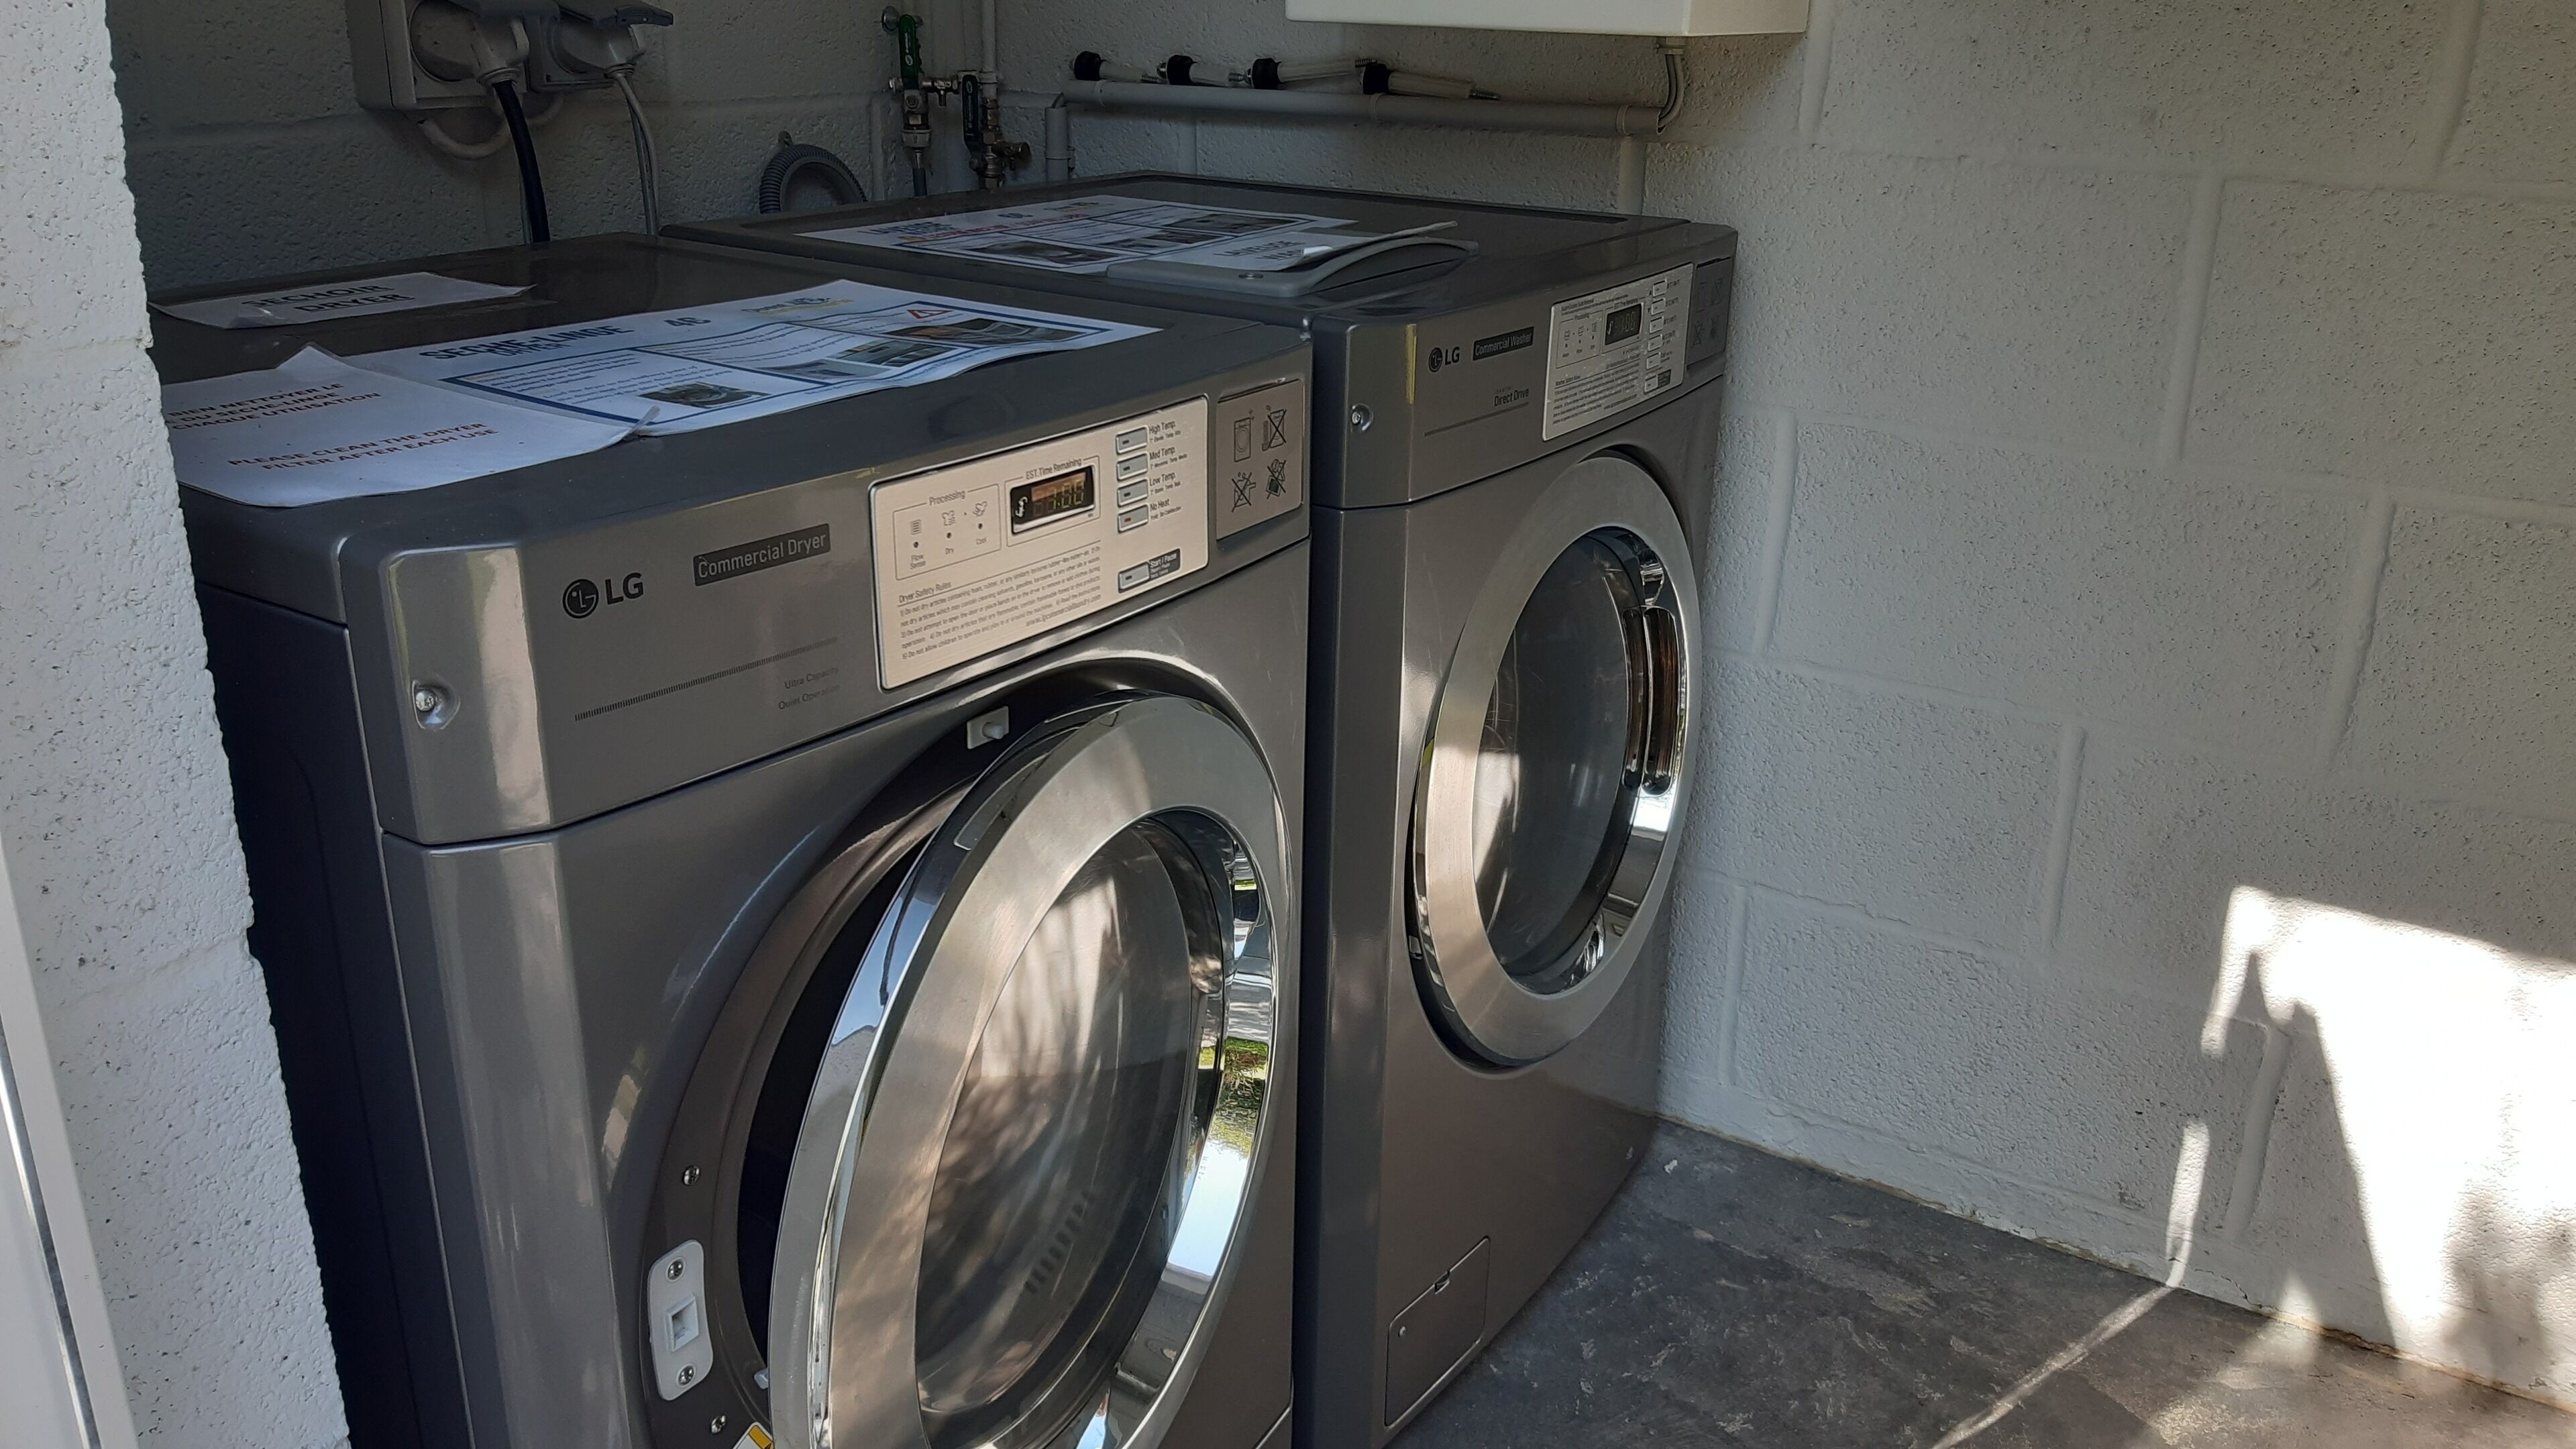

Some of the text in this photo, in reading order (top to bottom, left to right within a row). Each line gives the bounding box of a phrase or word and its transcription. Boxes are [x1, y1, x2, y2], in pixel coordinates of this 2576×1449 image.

[241, 284, 394, 307] SECHOIR
[294, 293, 415, 312] DRYER
[419, 325, 635, 360] SECHE-LINGE
[1476, 333, 1532, 356] Commercial Washer
[1445, 346, 1460, 366] LG
[168, 382, 344, 415] BIEN NETTOYER LE
[180, 392, 339, 422] DU SECHE-LINGE
[1494, 392, 1513, 407] Direct
[1513, 388, 1529, 401] Drive
[172, 392, 382, 430] CHAQUE UTILISATION
[1149, 425, 1161, 434] High
[227, 423, 487, 466] PLEASE CLEAN THE DRYER
[262, 429, 499, 470] FILTER AFTER EACH USE
[1053, 458, 1082, 472] Remaining
[1150, 451, 1161, 460] Med
[1150, 477, 1161, 486] Low
[929, 490, 965, 506] Processing
[1150, 503, 1157, 512] No
[1158, 498, 1170, 508] Heat
[698, 533, 826, 580] Commercial Dryer
[1150, 559, 1161, 568] Start
[1165, 553, 1177, 562] Pause
[606, 572, 644, 606] LG
[899, 594, 914, 603] Dryer
[916, 587, 934, 598] Safety
[784, 678, 804, 689] Ultra
[778, 696, 801, 710] Quiet
